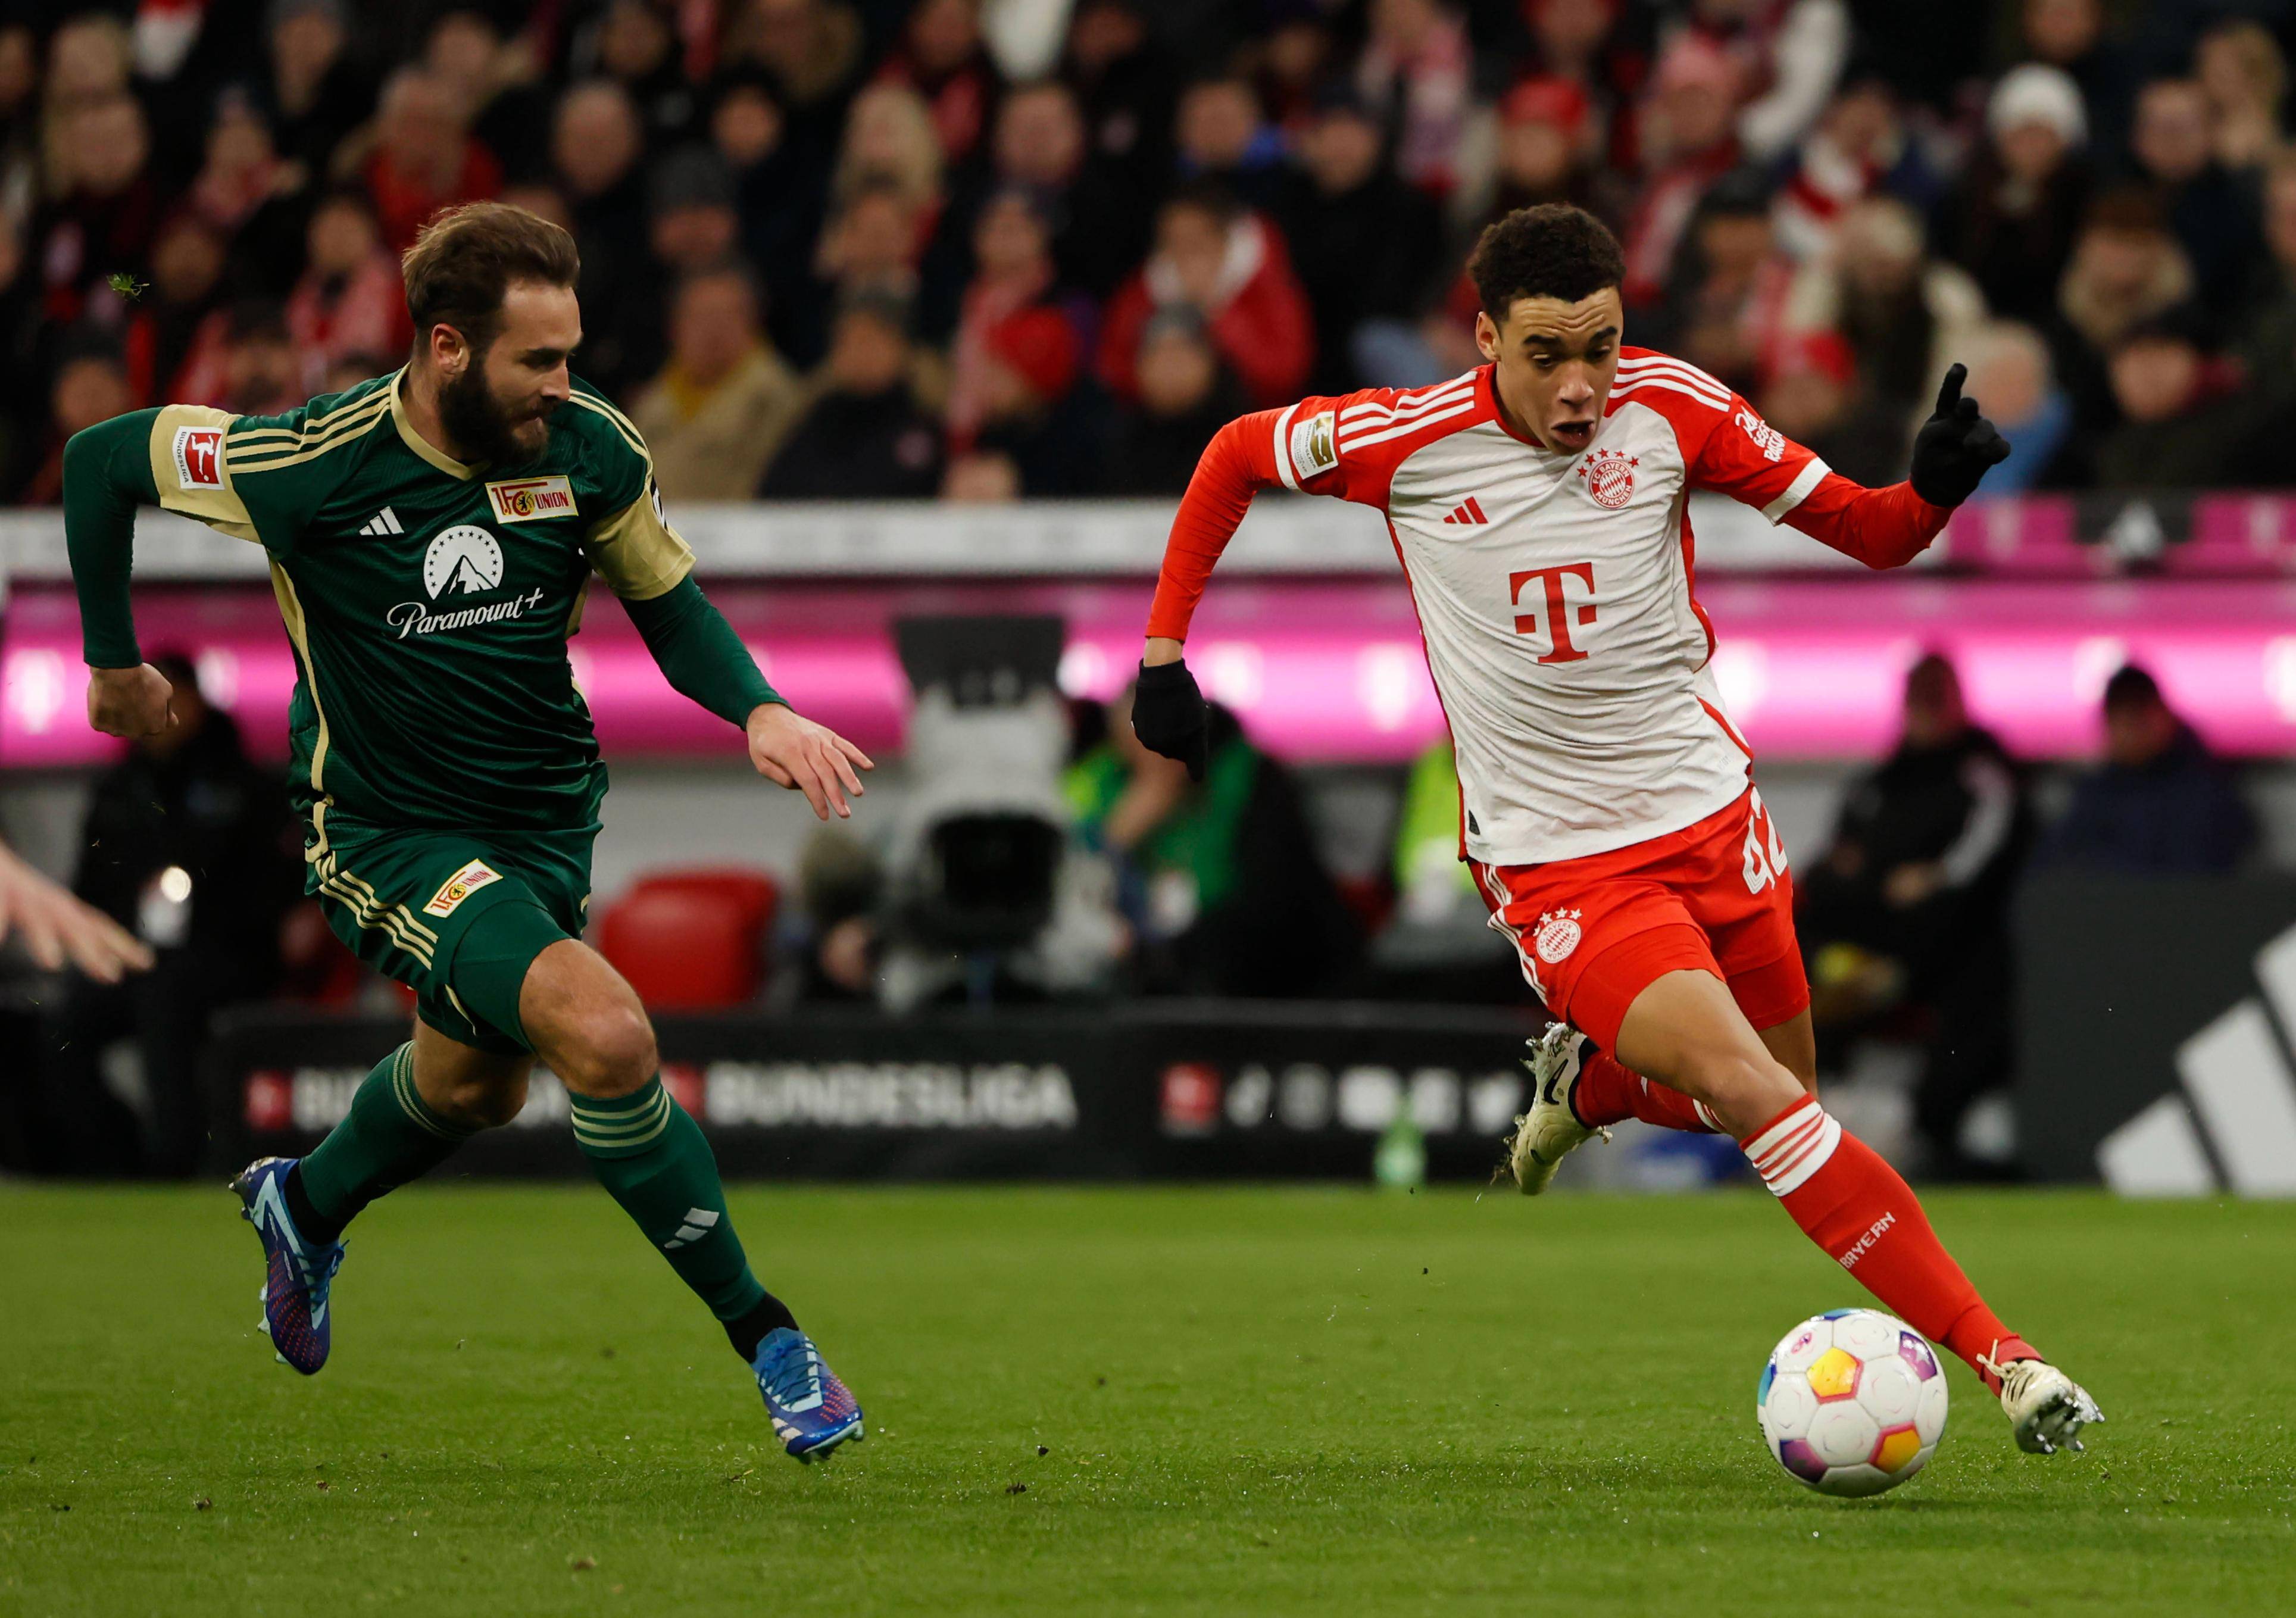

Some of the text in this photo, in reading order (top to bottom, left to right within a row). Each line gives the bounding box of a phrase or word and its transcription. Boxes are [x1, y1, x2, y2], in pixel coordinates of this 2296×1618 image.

[176, 432, 189, 483] BUNDESLIGA
[1592, 462, 1630, 484] FC BAYERN
[535, 491, 570, 510] UNION
[386, 587, 544, 640] Paramount+
[1510, 561, 1597, 664] T
[1742, 785, 1788, 895] 42
[461, 870, 492, 886] UNION
[1543, 922, 1572, 936] BAYERN
[705, 1060, 1079, 1130] BUNDESLIGA
[1839, 1211, 1897, 1269] BAYERN
